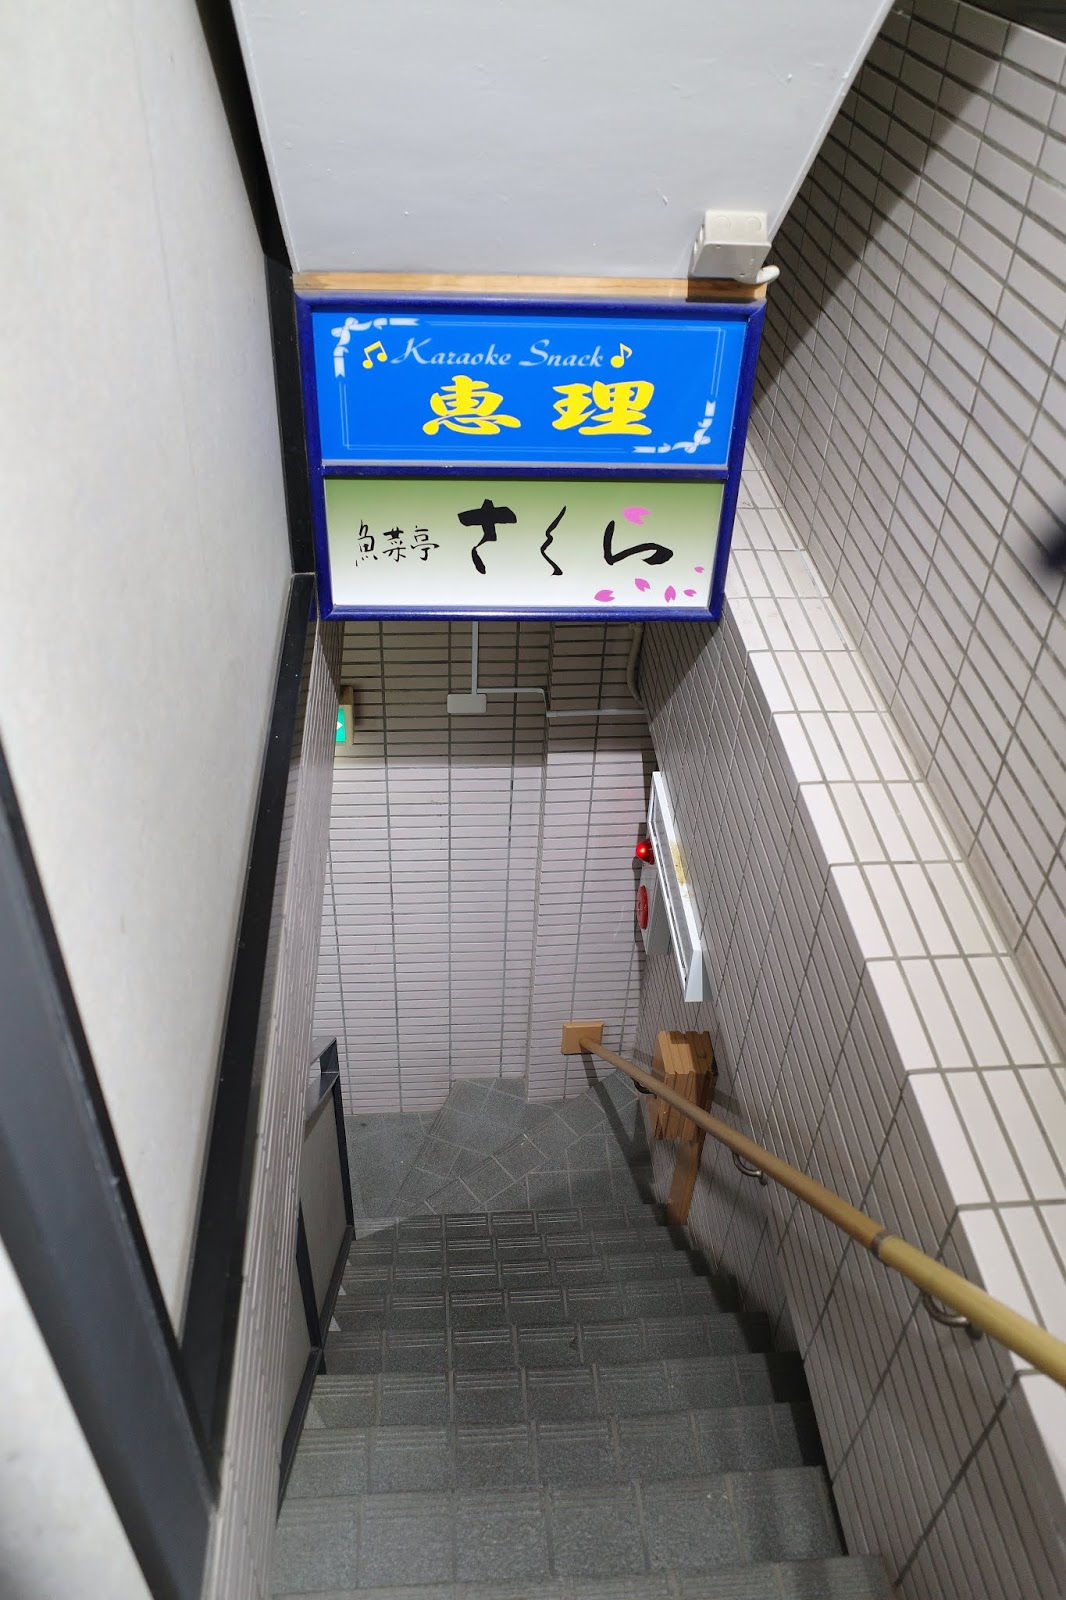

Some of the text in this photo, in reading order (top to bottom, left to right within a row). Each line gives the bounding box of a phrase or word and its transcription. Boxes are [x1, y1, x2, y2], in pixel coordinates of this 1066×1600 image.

[390, 337, 604, 367] Karaoke Snack
[355, 498, 674, 576] 魚菜亭 さくら
